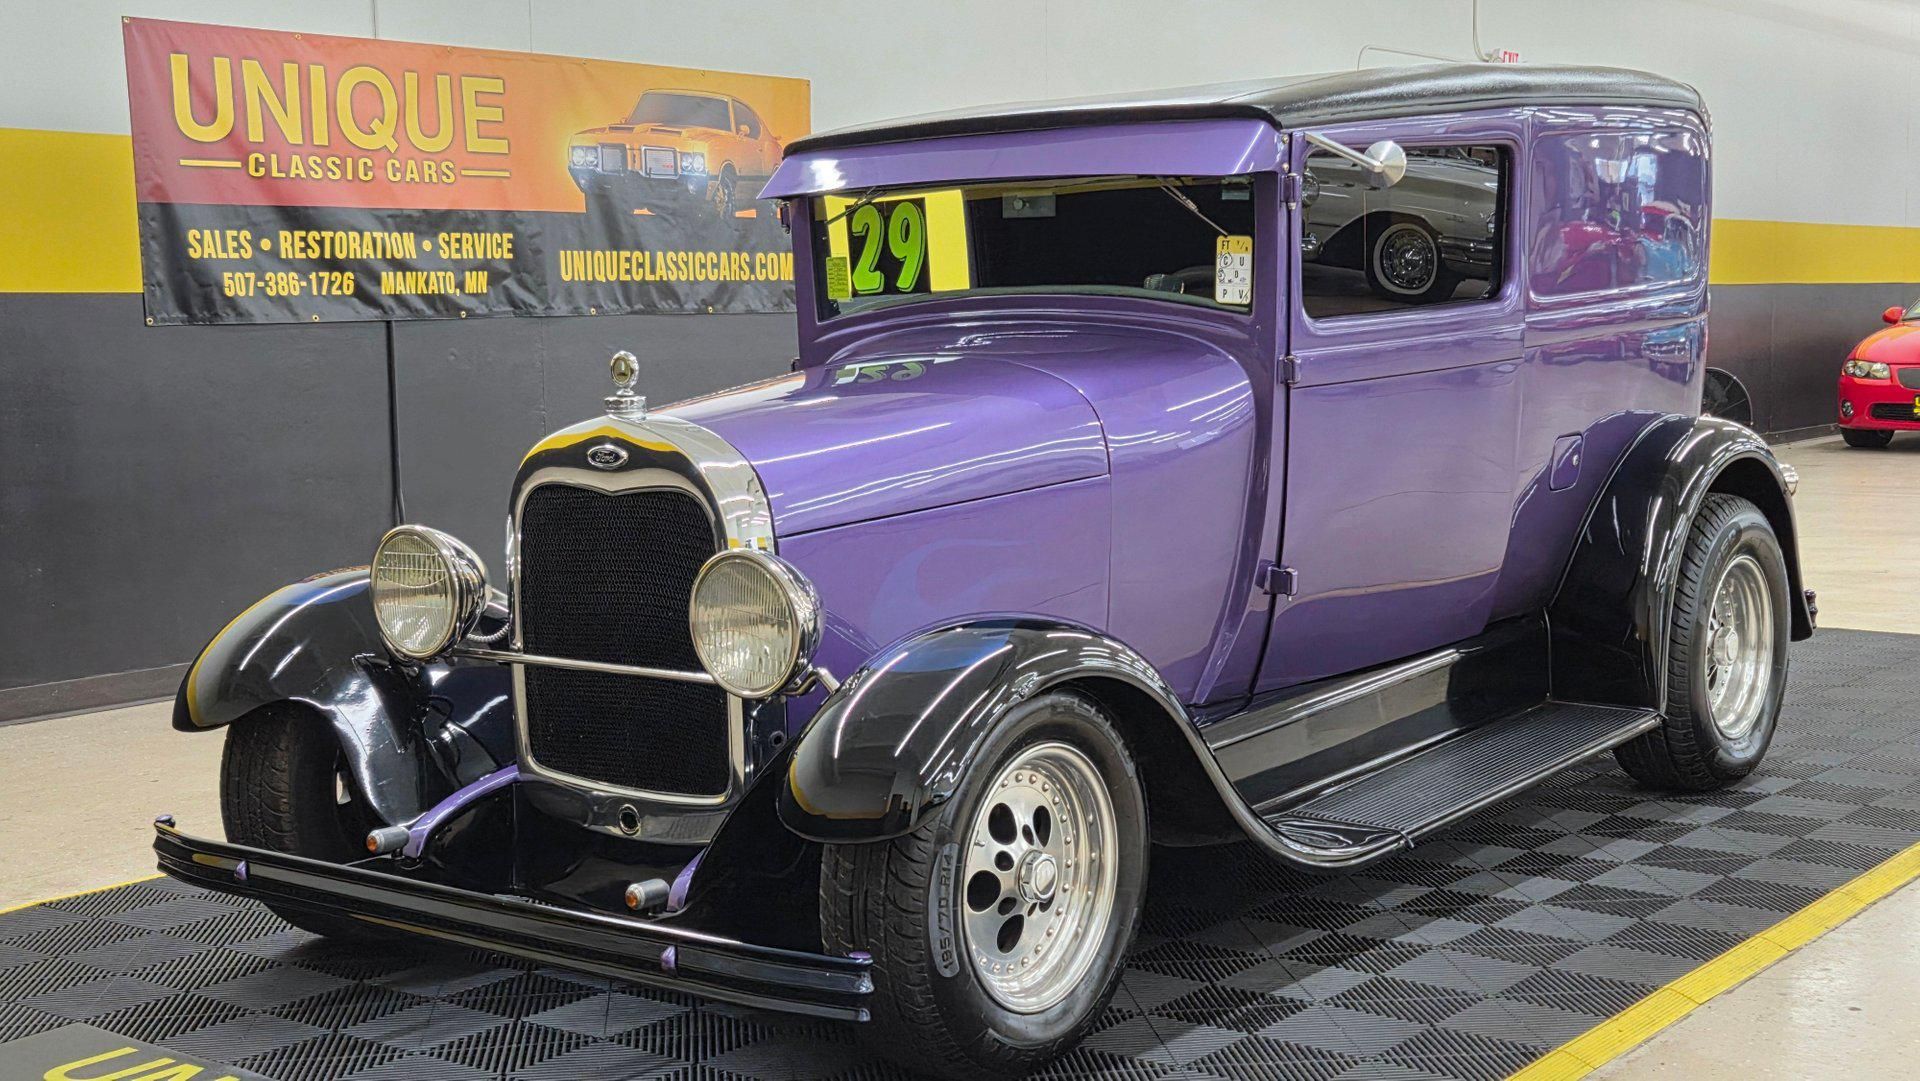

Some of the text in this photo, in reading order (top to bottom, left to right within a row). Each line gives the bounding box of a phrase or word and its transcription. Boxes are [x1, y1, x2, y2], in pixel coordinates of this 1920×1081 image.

[170, 53, 509, 154] UNIQUE
[248, 152, 456, 184] CLASSIC CARS
[187, 229, 514, 260] SALES RESTORATION SERVICE
[851, 201, 926, 294] 29
[559, 250, 794, 282] UNIQUECLASSICCARS.COM
[222, 270, 488, 297] 507-386-1726 MANKATO, MN
